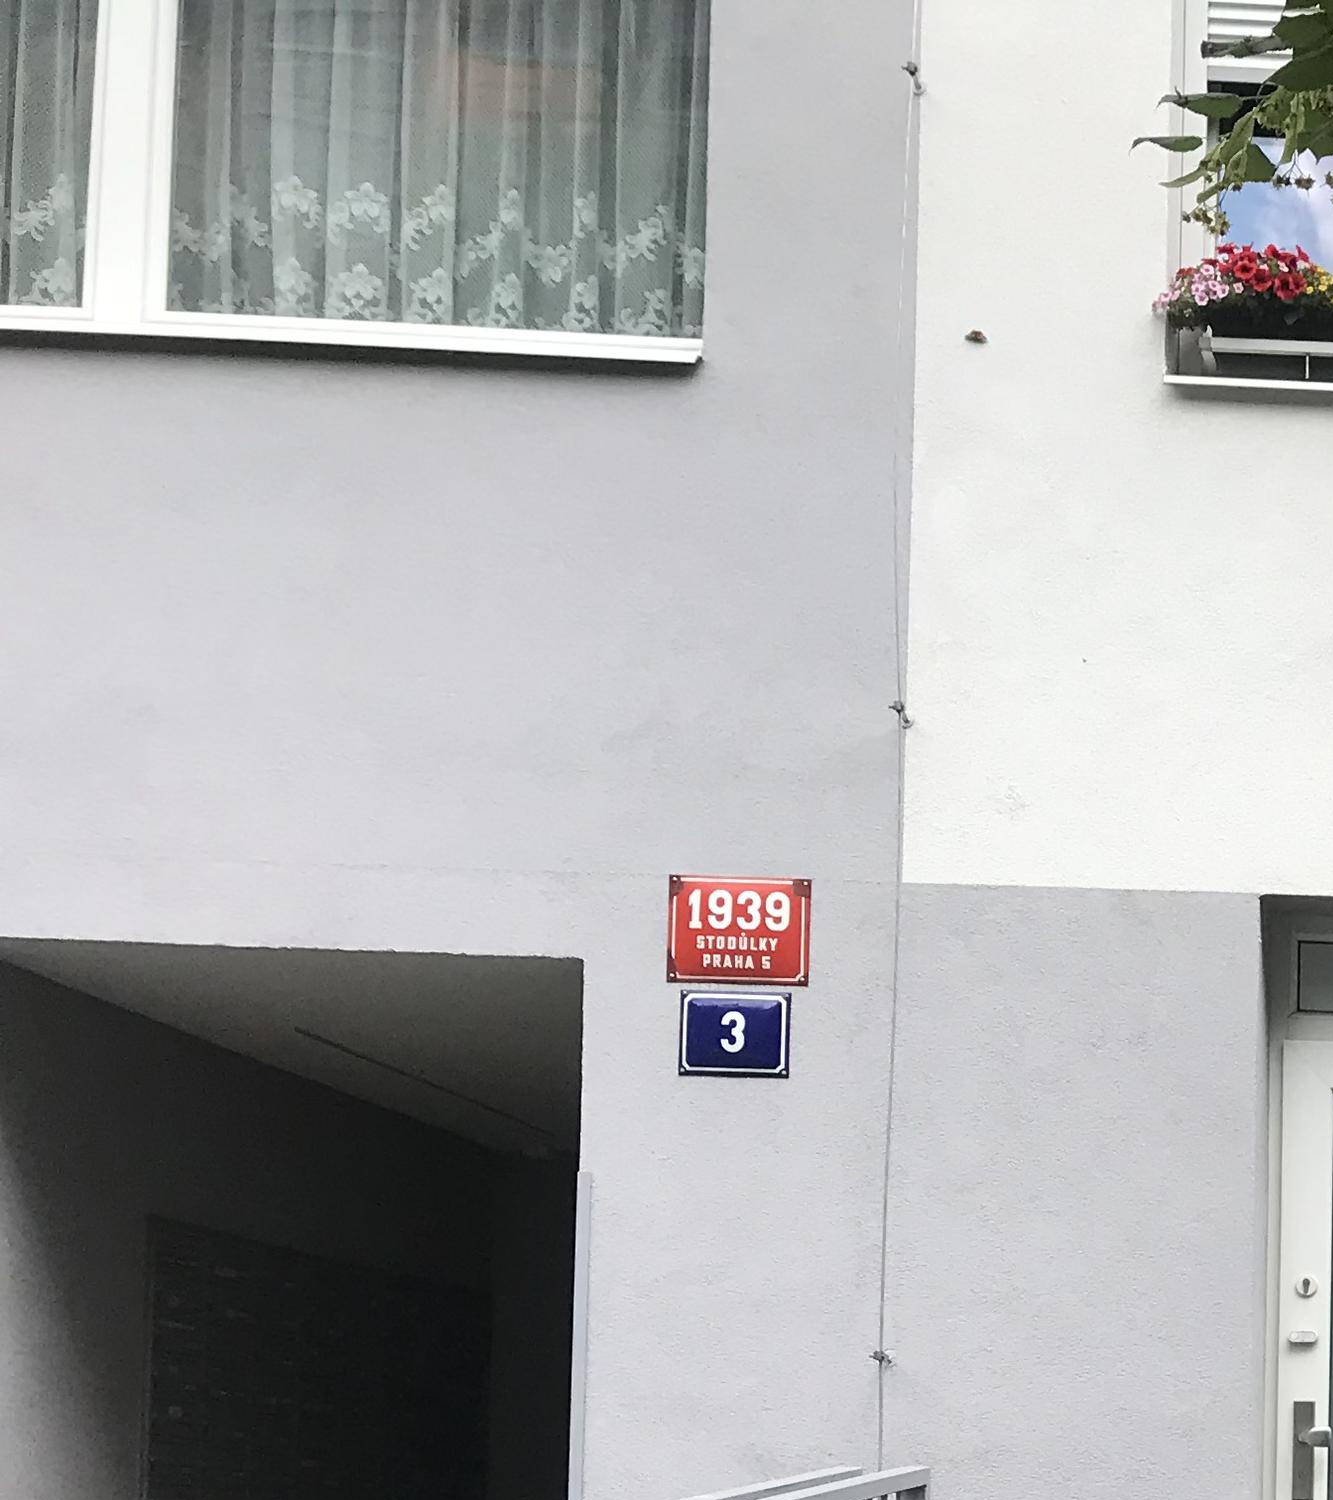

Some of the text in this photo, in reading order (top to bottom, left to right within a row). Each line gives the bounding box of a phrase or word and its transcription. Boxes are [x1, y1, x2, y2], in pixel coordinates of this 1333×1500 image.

[688, 889, 791, 932] 1939
[696, 932, 778, 952] STODŮLKY
[703, 953, 771, 970] PRAHA 5
[720, 1011, 746, 1053] 3
